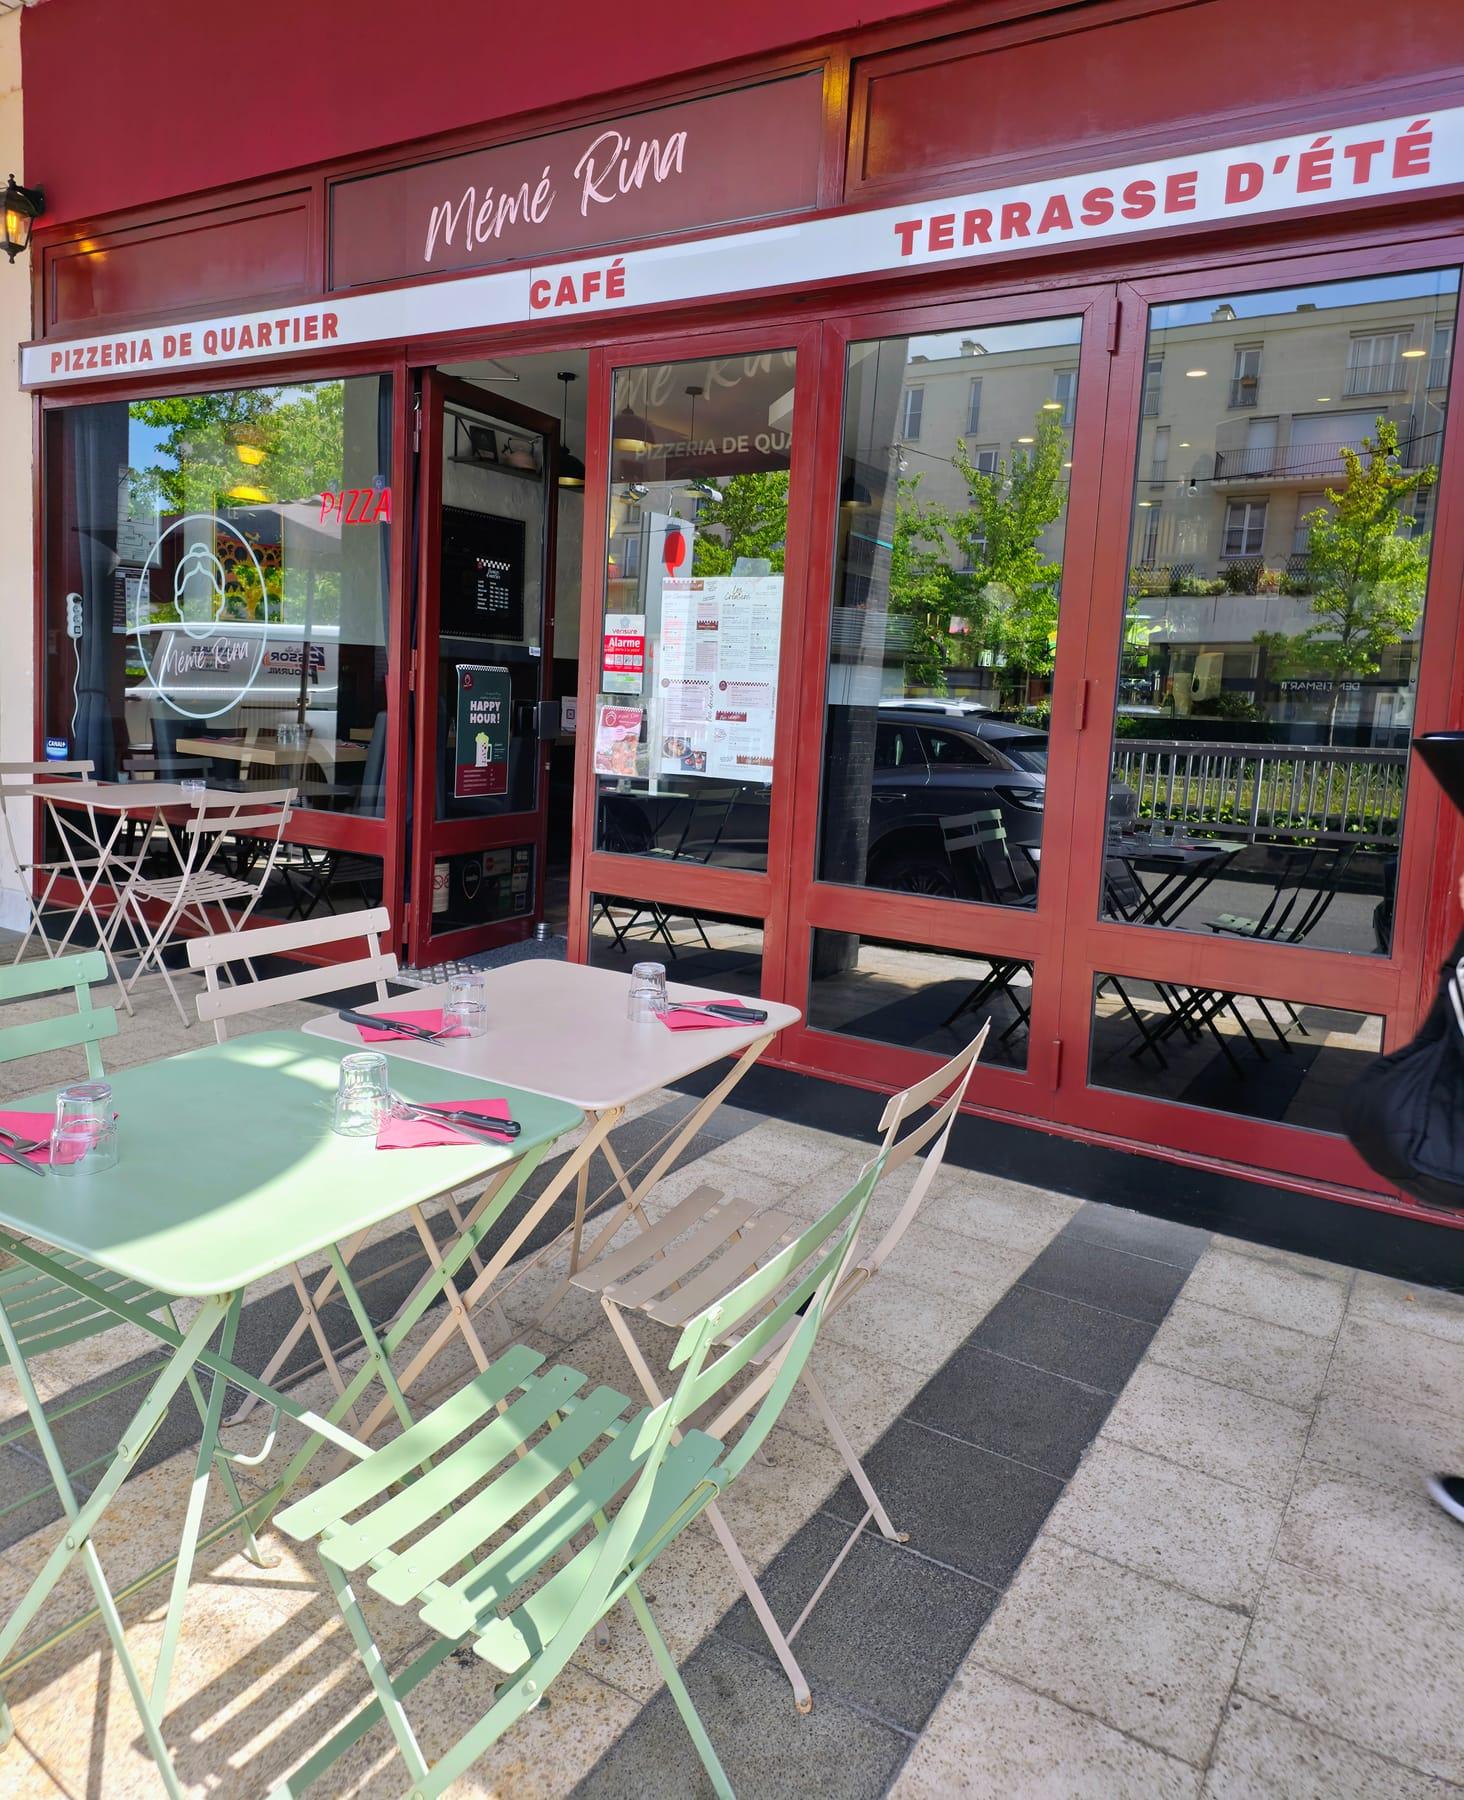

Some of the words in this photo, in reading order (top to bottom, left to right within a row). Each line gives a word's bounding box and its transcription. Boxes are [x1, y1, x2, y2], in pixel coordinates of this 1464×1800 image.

[425, 166, 555, 262] Mémé
[574, 130, 688, 217] Rina
[894, 171, 1198, 256] TERRASSE
[530, 259, 627, 311] CAFÉ
[51, 338, 153, 373] PIZZERIA
[163, 332, 192, 359] DE
[203, 313, 339, 356] QUARTIER
[635, 440, 717, 461] PIZZERIA
[722, 435, 749, 454] DE
[320, 487, 392, 525] PIZZA
[608, 637, 641, 648] Alarme
[469, 713, 501, 724] HOUR!
[470, 700, 501, 712] HAPPY
